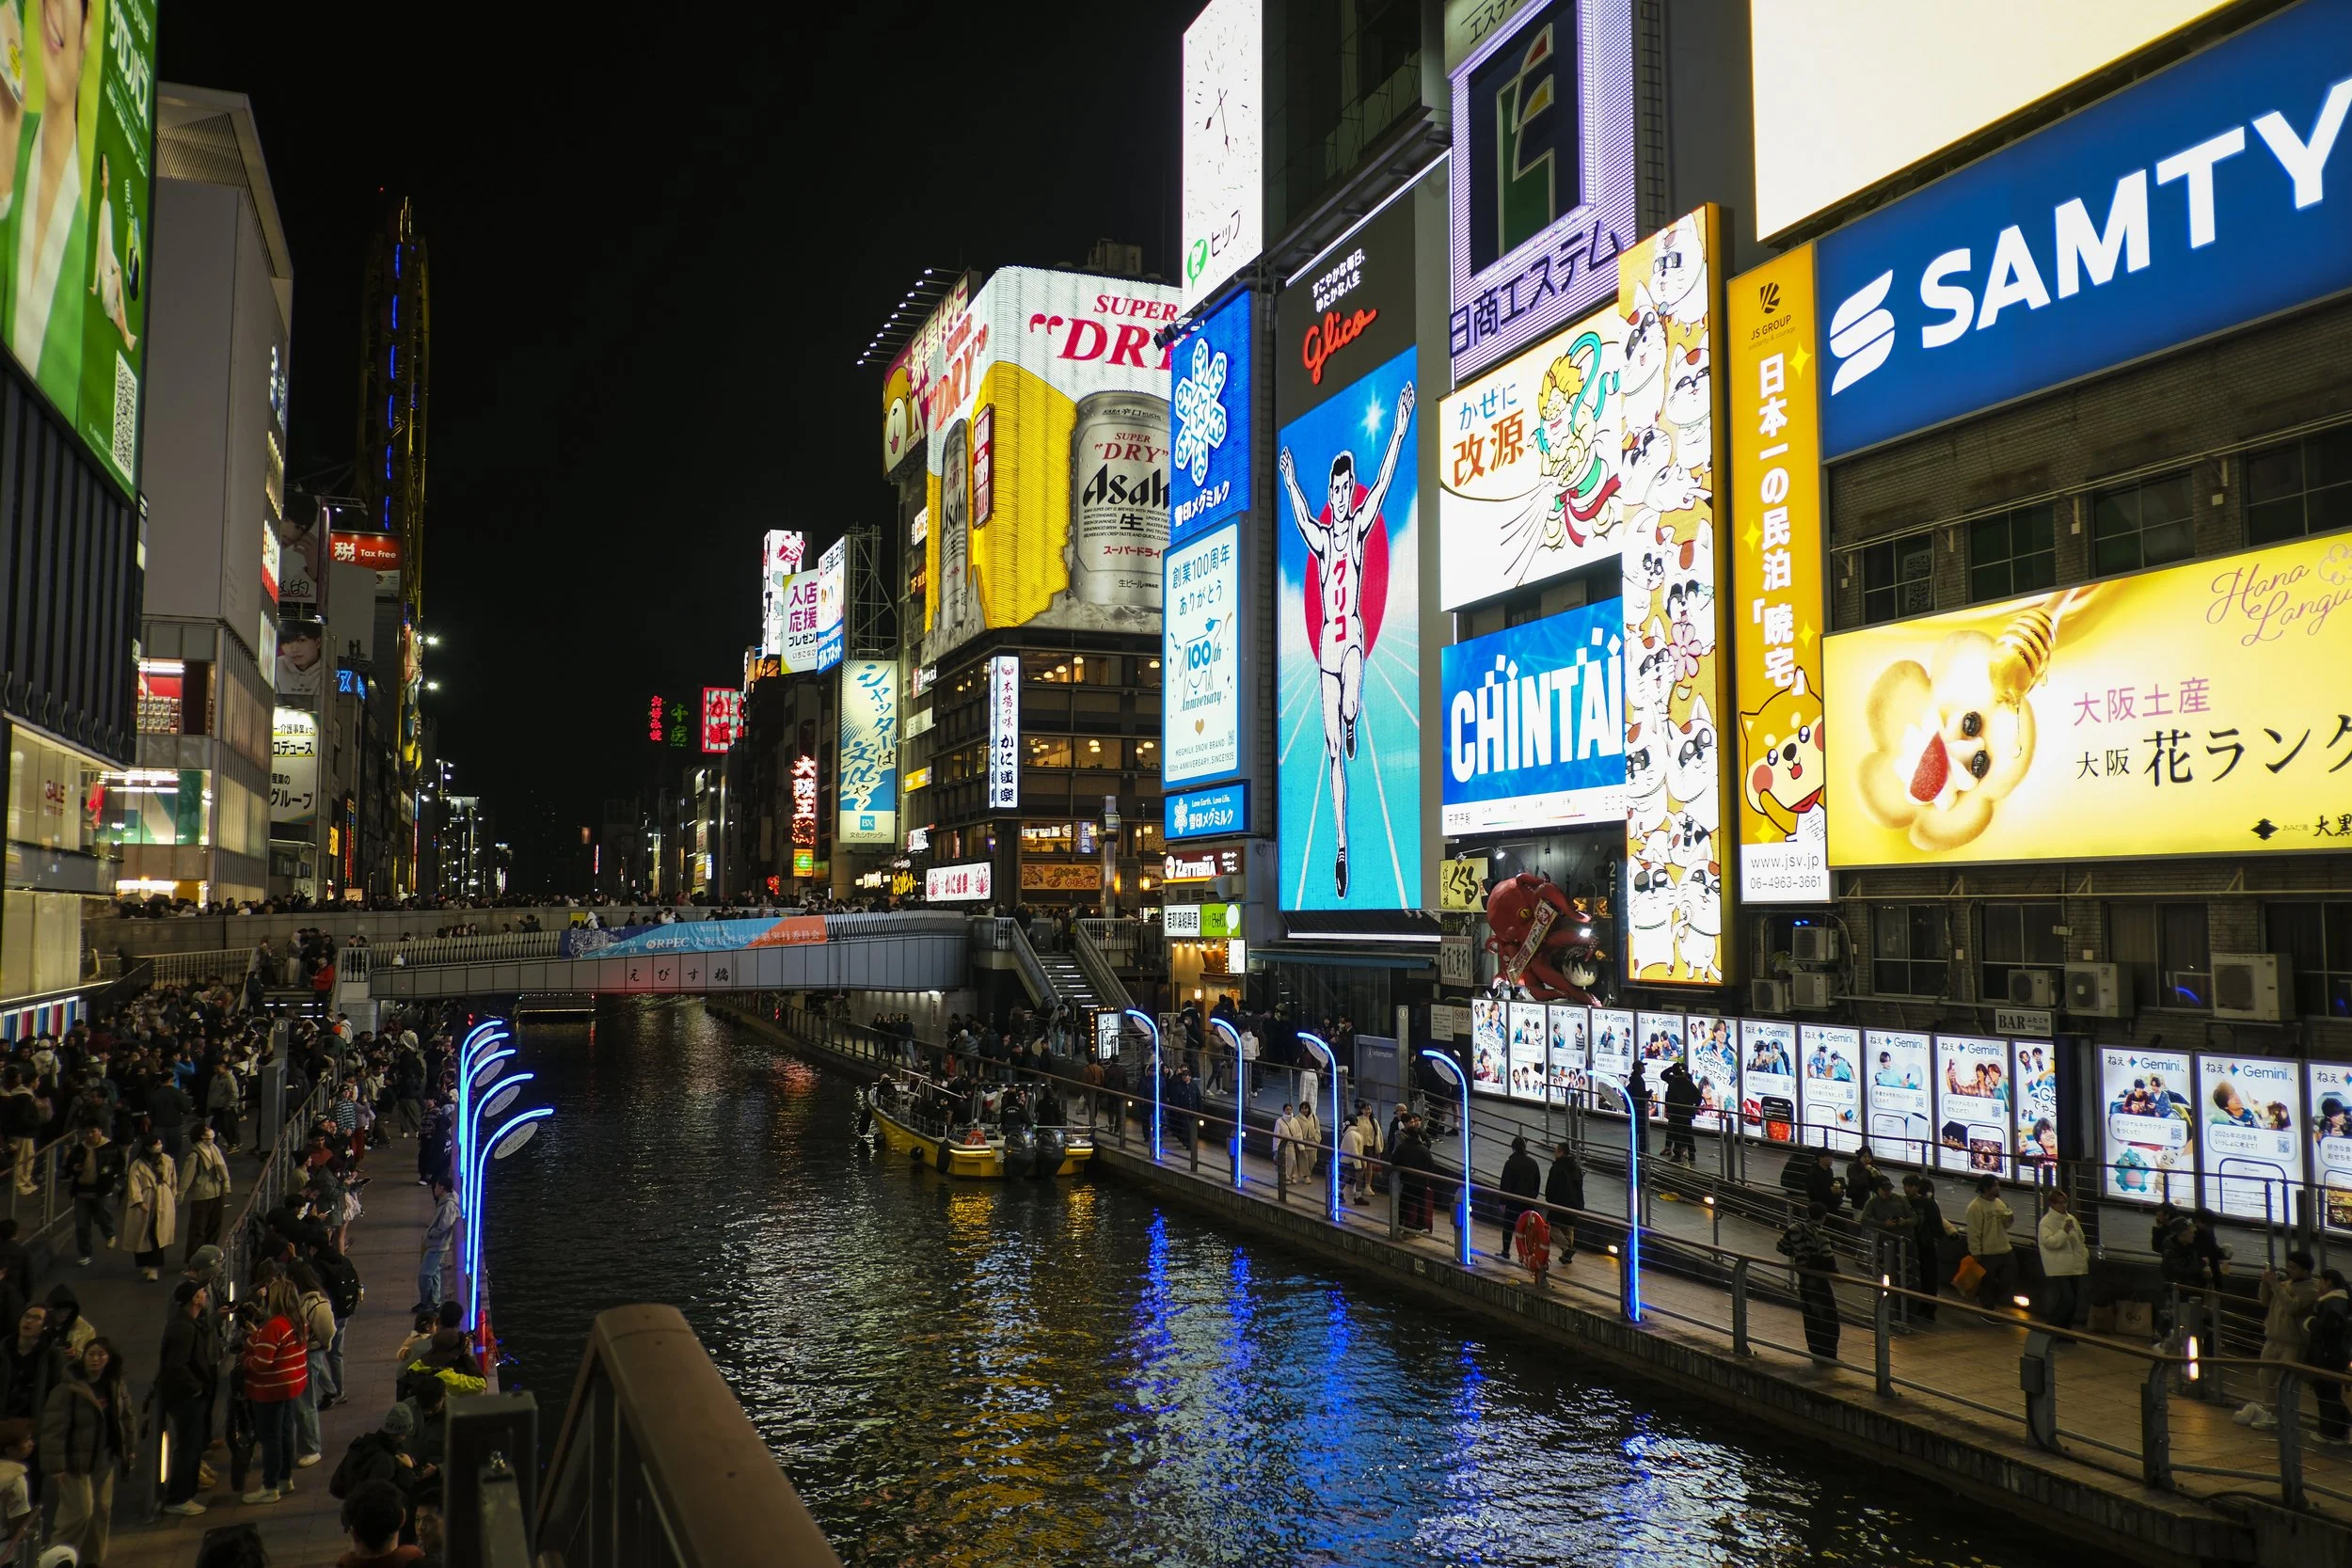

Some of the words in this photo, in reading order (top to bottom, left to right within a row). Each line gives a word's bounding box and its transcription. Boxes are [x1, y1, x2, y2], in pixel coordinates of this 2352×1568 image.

[1920, 77, 2352, 348] SAMTY
[1312, 248, 1366, 297] すこやかな毎日、
[1315, 272, 1361, 313] ゆたかな人生
[1449, 219, 1623, 358] 日商エステム
[1093, 293, 1179, 323] SUPER
[1751, 330, 1761, 341] JS
[1762, 314, 1792, 338] GROUP
[1459, 382, 1518, 431] かぜに
[1115, 433, 1151, 443] SUPER
[1453, 407, 1525, 488] 改源
[1083, 463, 1170, 509] Asah
[1120, 513, 1144, 531] 生
[334, 542, 356, 562] 税
[360, 549, 375, 558] Tax
[378, 550, 396, 559] Free
[1104, 546, 1161, 559] スーパードライ
[1172, 543, 1231, 590] 創業100周年
[789, 581, 817, 609] 入店
[1179, 579, 1223, 616] ありがとう
[1332, 552, 1347, 643] グリコ
[2207, 563, 2310, 625] Hana
[789, 607, 817, 633] 応援
[1000, 680, 1013, 729] 本場の味
[1180, 690, 1222, 712] Anniversary
[1450, 645, 1625, 783] CHINTAI
[2074, 677, 2211, 726] 大阪土産
[1196, 743, 1209, 752] SNOW
[1210, 739, 1225, 750] BRAND
[1000, 735, 1013, 802] かに道楽
[2076, 748, 2131, 780] 大阪
[861, 818, 874, 828] BX
[1189, 807, 1233, 830] 雪印メグミルク
[1751, 854, 1820, 870] www.jsv.jp
[1750, 875, 1821, 890] 06-4963-3661
[628, 968, 729, 983] えびす橋
[1998, 1015, 2026, 1029] BAR
[1702, 1052, 1732, 1076] Gemini
